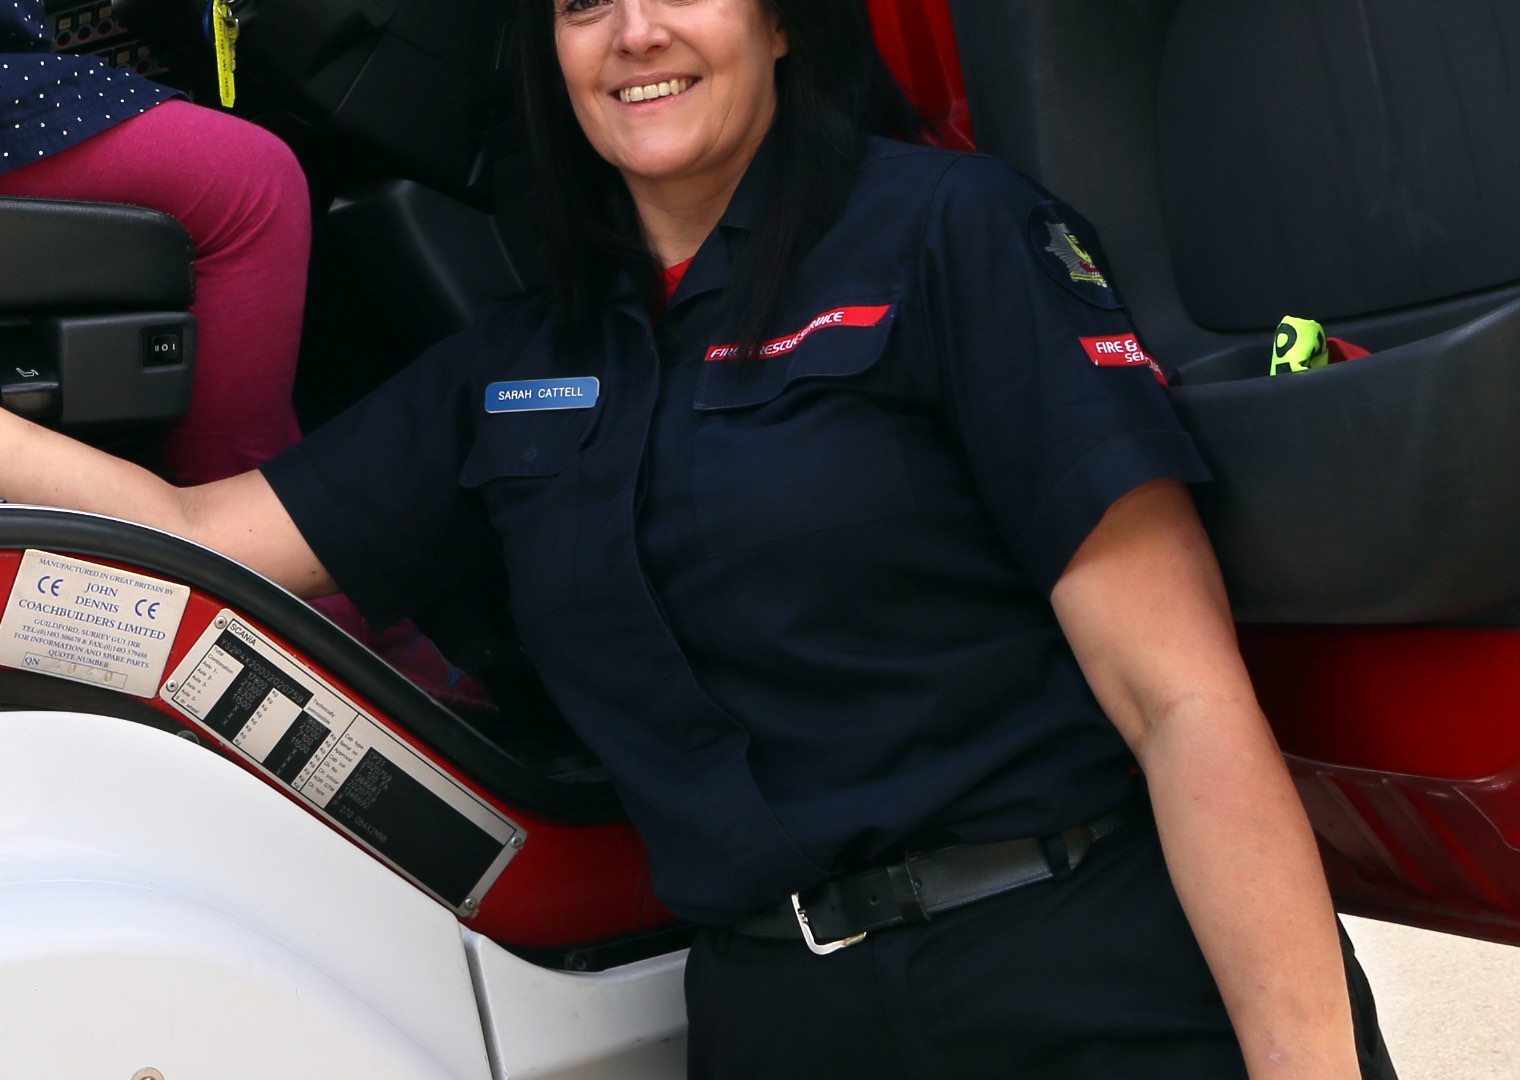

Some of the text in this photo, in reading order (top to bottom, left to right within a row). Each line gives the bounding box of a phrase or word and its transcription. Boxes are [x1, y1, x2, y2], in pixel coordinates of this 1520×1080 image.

[1096, 339, 1137, 353] FIRE &
[498, 387, 583, 400] SARAH CATTELL
[39, 558, 174, 596] MANUFACTURED IN GREAT BRITAIN BY
[84, 582, 119, 599] JOHN
[75, 596, 120, 614] DENNIS
[18, 598, 166, 641] COACHBUILDERS LIMITED
[34, 618, 80, 635] GUILDFORD,
[81, 629, 111, 642] SURREY
[228, 622, 258, 646] SCANIA
[14, 633, 149, 669] FOR INFORMATION AND SPARE PARTS
[24, 656, 41, 667] QN
[48, 649, 110, 669] QUOTE NUMBER
[207, 654, 235, 675] Combination
[265, 697, 274, 705] Kg
[212, 646, 225, 657] Total
[271, 690, 279, 698] Kg
[197, 667, 208, 677] Axle
[255, 711, 263, 719] Kg
[202, 661, 213, 670] Axle
[260, 704, 269, 712] Kg
[186, 681, 197, 691] Axle
[244, 725, 253, 733] Kg
[191, 674, 202, 684] Axle
[250, 718, 258, 726] Kg
[312, 698, 337, 718] Technically
[181, 688, 191, 698] Axle
[239, 731, 248, 740] Kg
[339, 741, 352, 751] Serial
[344, 734, 354, 743] Cab
[354, 741, 364, 750] type
[328, 755, 338, 763] Cab
[333, 748, 353, 763] Approval
